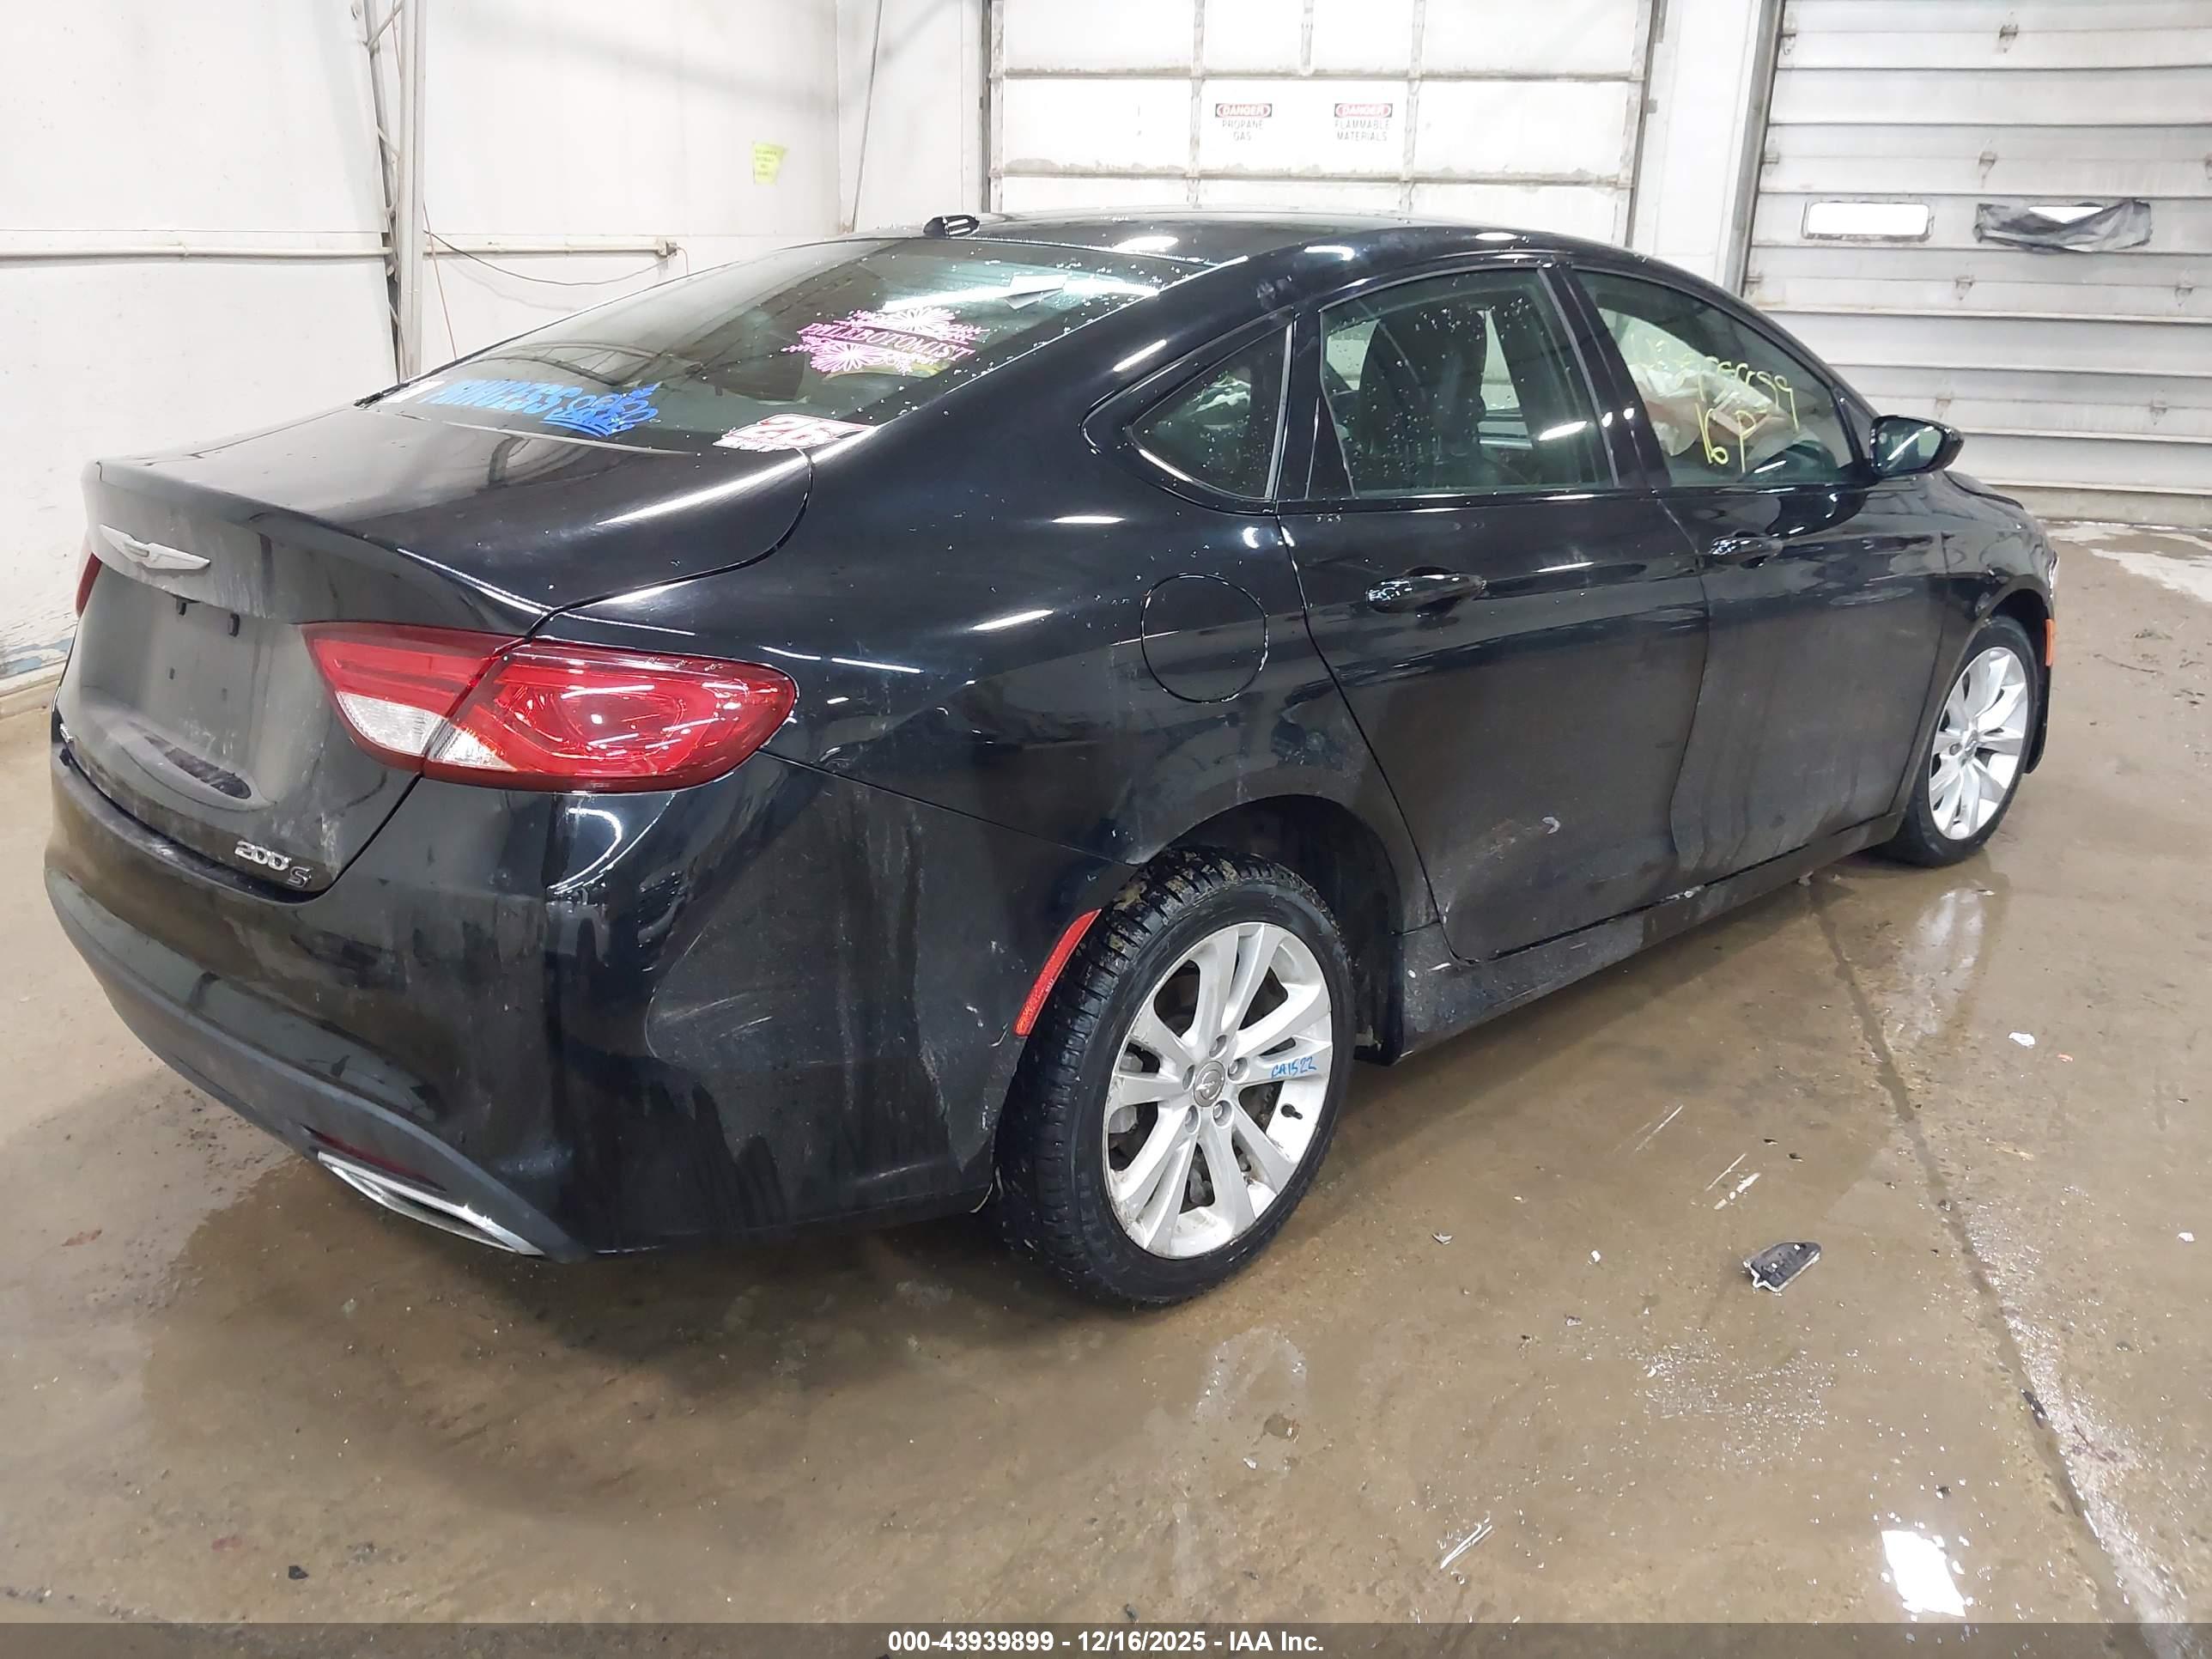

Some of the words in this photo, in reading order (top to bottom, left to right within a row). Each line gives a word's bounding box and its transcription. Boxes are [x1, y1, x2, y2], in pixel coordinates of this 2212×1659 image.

[1222, 104, 1264, 116] DANGER
[1341, 104, 1384, 116] DANGER
[1222, 119, 1264, 130] PROPANE
[1334, 119, 1389, 130] FLAMMABLE
[1233, 131, 1251, 141] GAS
[1336, 131, 1388, 142] MATERIALS
[797, 323, 975, 361] PHLEBOTOMIST
[417, 379, 584, 415] PRINCESS
[234, 841, 291, 871] 200
[286, 866, 314, 888] S
